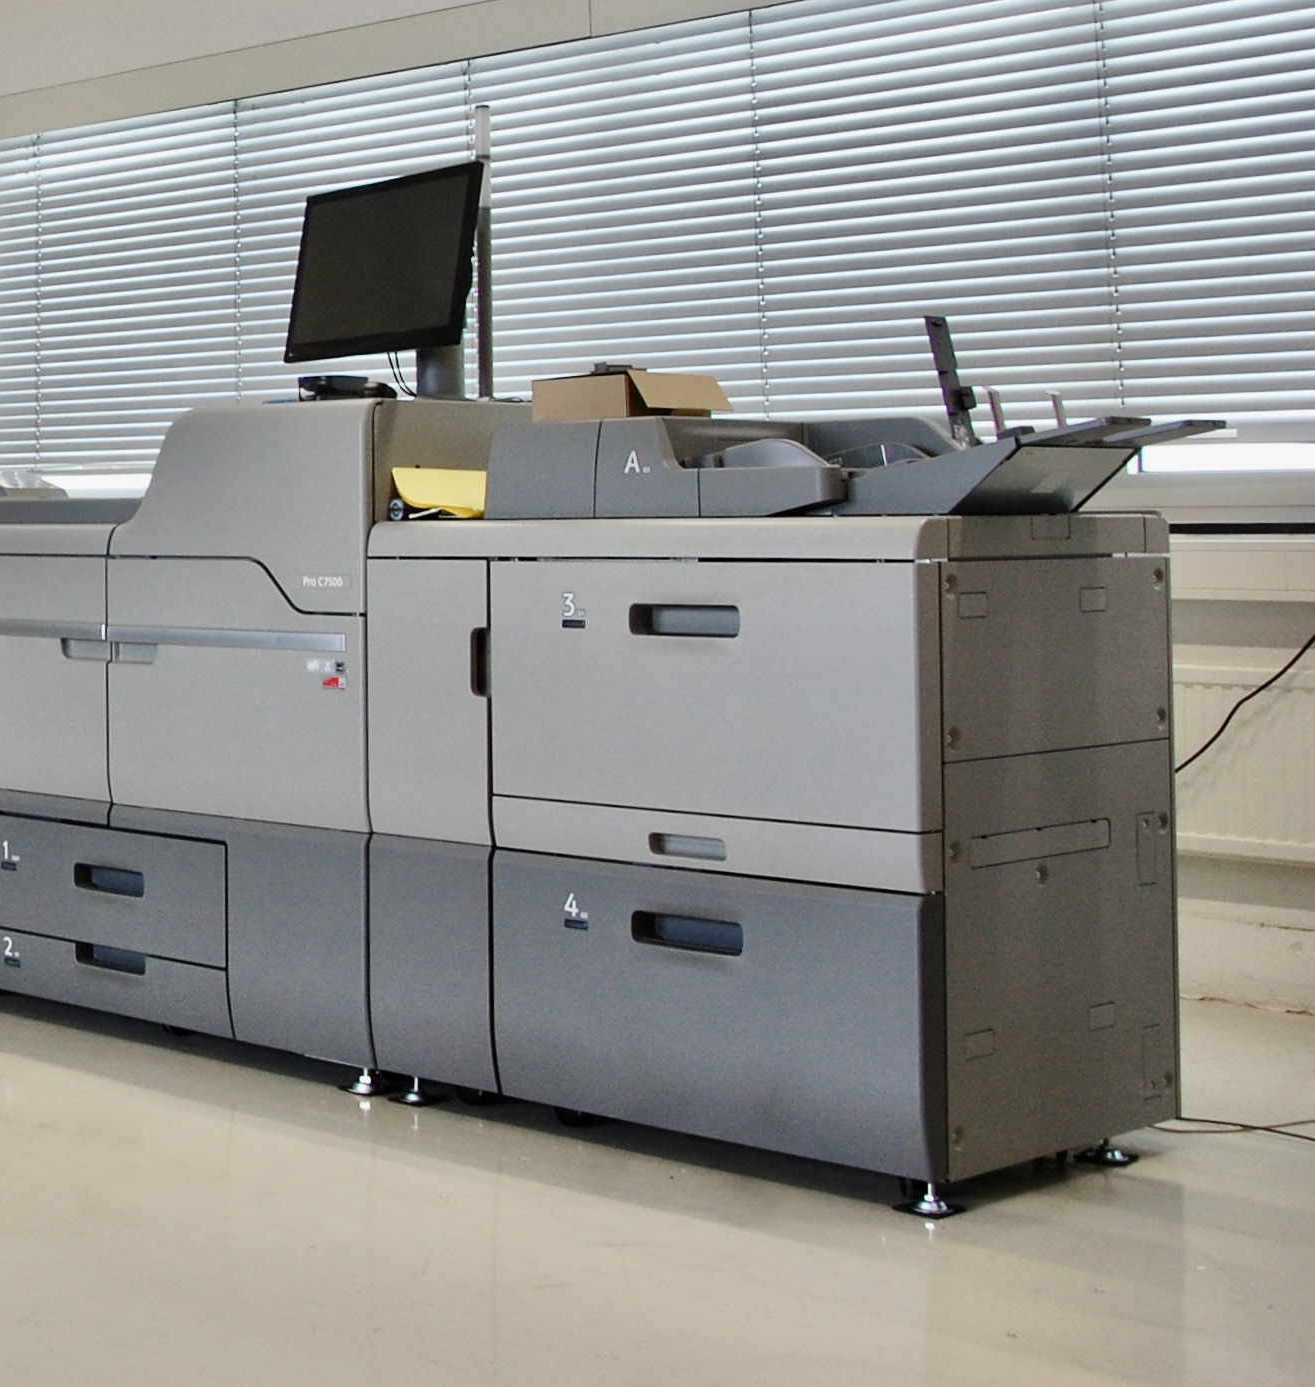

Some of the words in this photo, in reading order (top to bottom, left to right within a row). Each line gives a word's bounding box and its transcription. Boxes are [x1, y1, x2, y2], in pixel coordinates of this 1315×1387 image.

[624, 450, 640, 474] A
[302, 576, 317, 587] Pro
[318, 576, 343, 588] C7500
[563, 593, 575, 617] 3
[2, 840, 8, 860] 1
[564, 892, 579, 917] 4
[3, 936, 13, 956] 2
